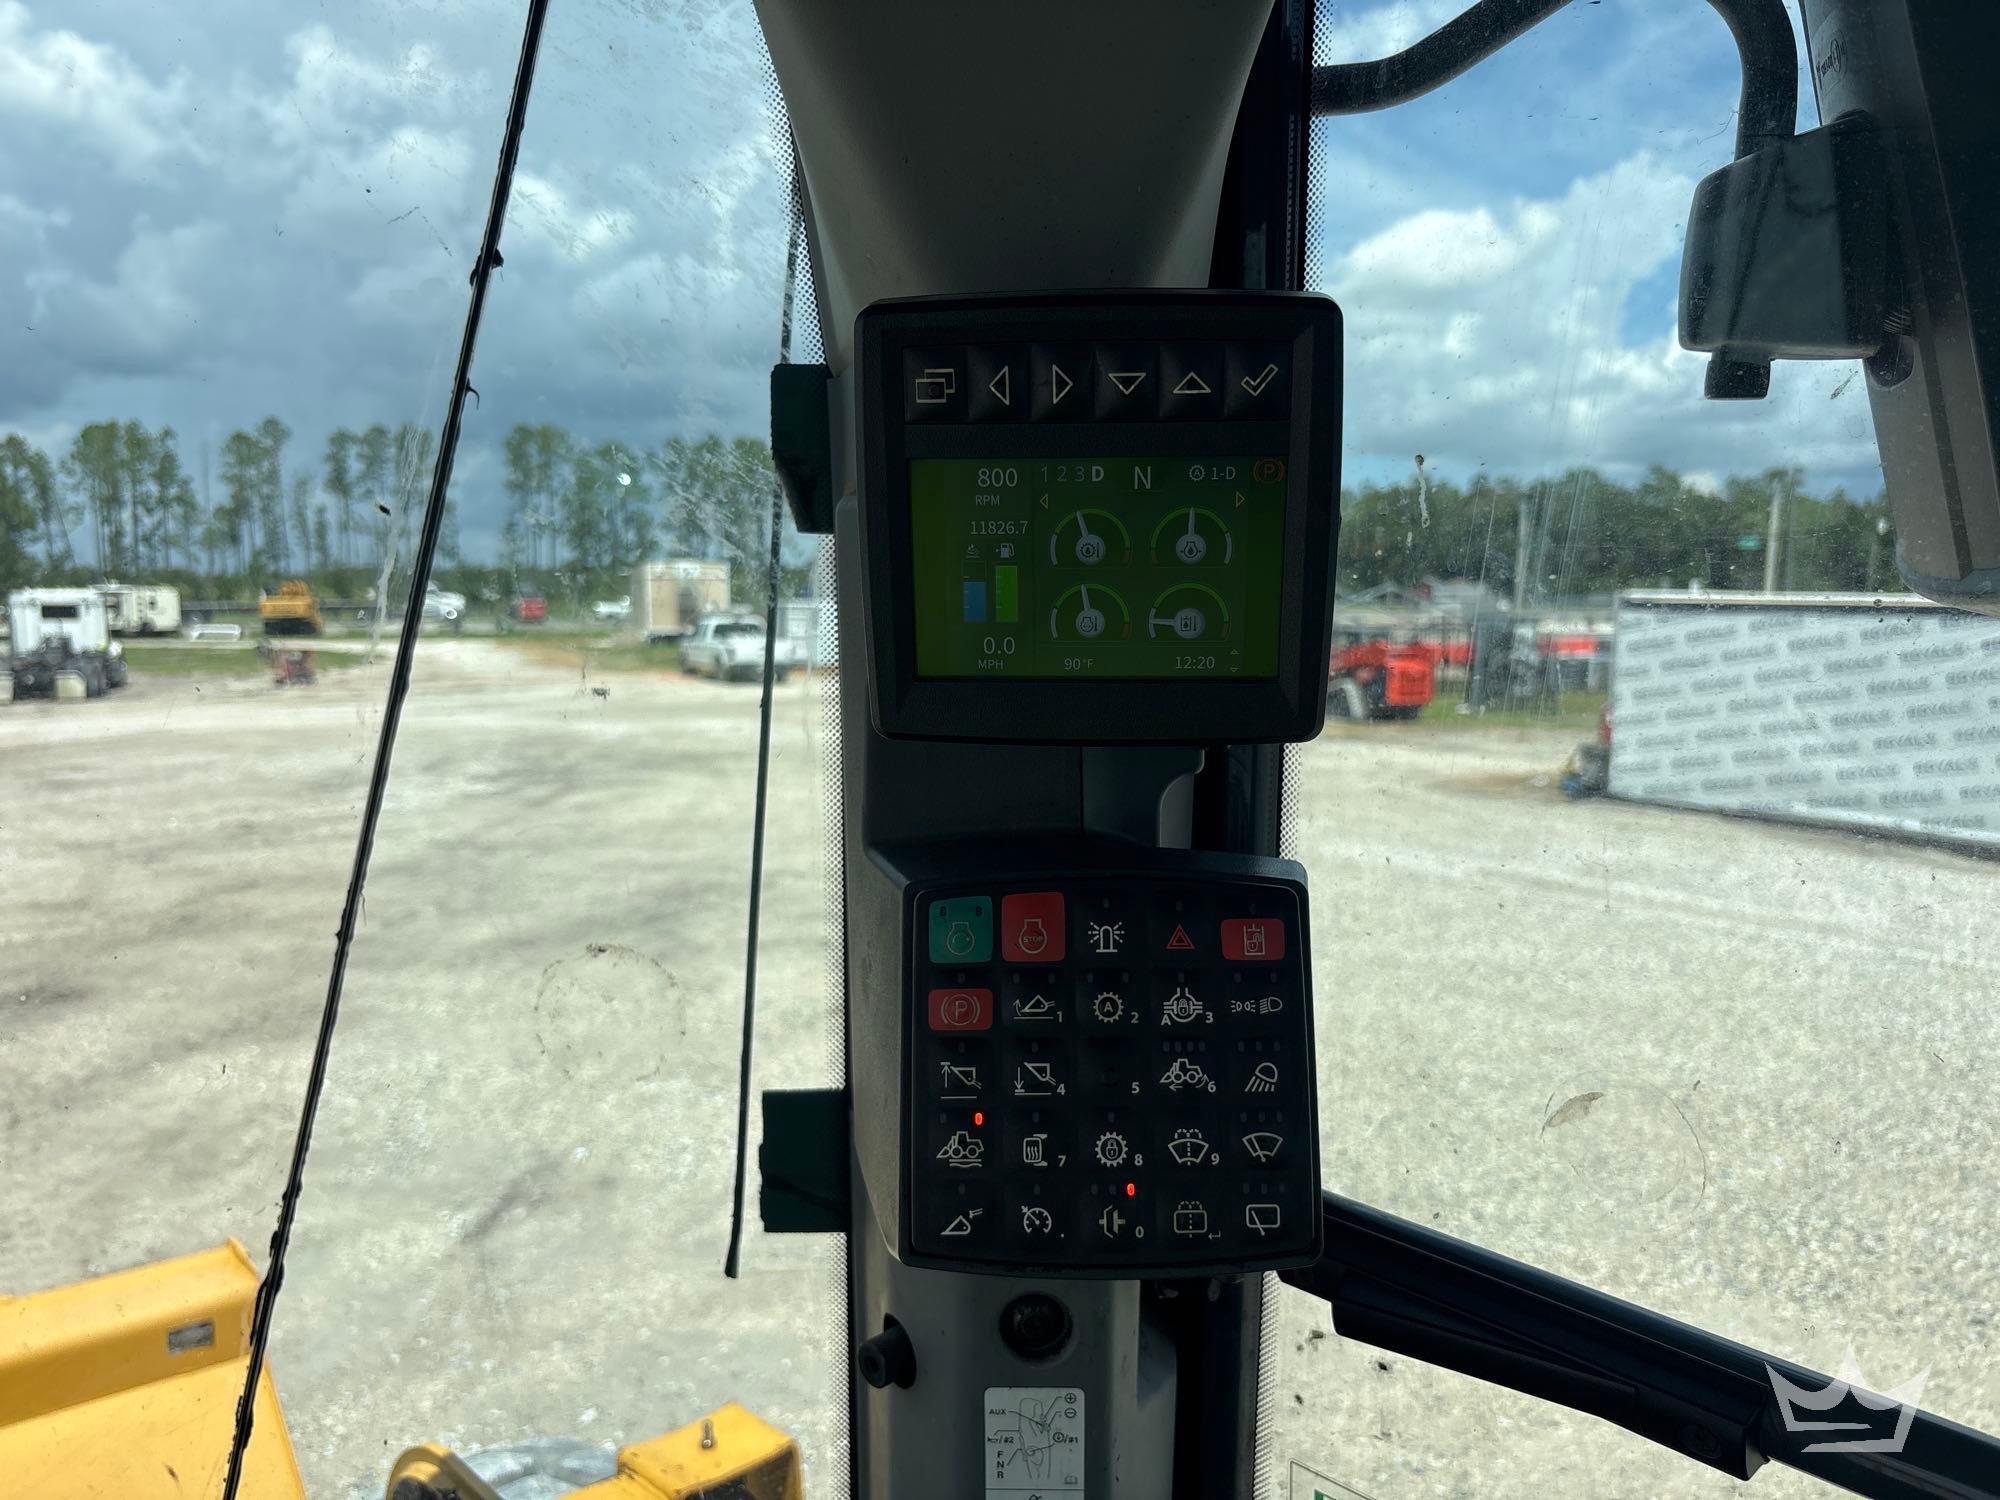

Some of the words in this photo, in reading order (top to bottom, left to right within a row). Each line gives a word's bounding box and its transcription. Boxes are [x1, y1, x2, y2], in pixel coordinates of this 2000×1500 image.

[977, 468, 1018, 488] 800
[1041, 467, 1049, 482] 1
[1056, 466, 1068, 482] 2
[1074, 466, 1085, 482] 3
[1091, 466, 1105, 482] D
[1134, 465, 1151, 490] N
[1212, 466, 1236, 480] 1-D
[975, 495, 1000, 506] RPM
[970, 520, 1029, 535] 11826.7
[983, 636, 1016, 655] 0.0
[977, 659, 1004, 670] MPH
[1175, 656, 1215, 670] 12:20
[1023, 935, 1043, 943] STOP
[955, 1000, 968, 1020] P
[1103, 1001, 1114, 1013] A
[1056, 1011, 1063, 1023] 1
[1131, 1011, 1140, 1024] 2
[1161, 1015, 1172, 1027] A
[1205, 1011, 1214, 1024] 3
[1056, 1082, 1066, 1095] 4
[1131, 1081, 1140, 1094] 5
[1207, 1081, 1217, 1094] 6
[1057, 1154, 1067, 1167] 7
[1134, 1153, 1143, 1167] 8
[1210, 1153, 1220, 1167] 9
[1135, 1226, 1144, 1239] 0
[997, 1450, 1004, 1458] F
[997, 1460, 1004, 1468] N
[997, 1471, 1004, 1479] R
